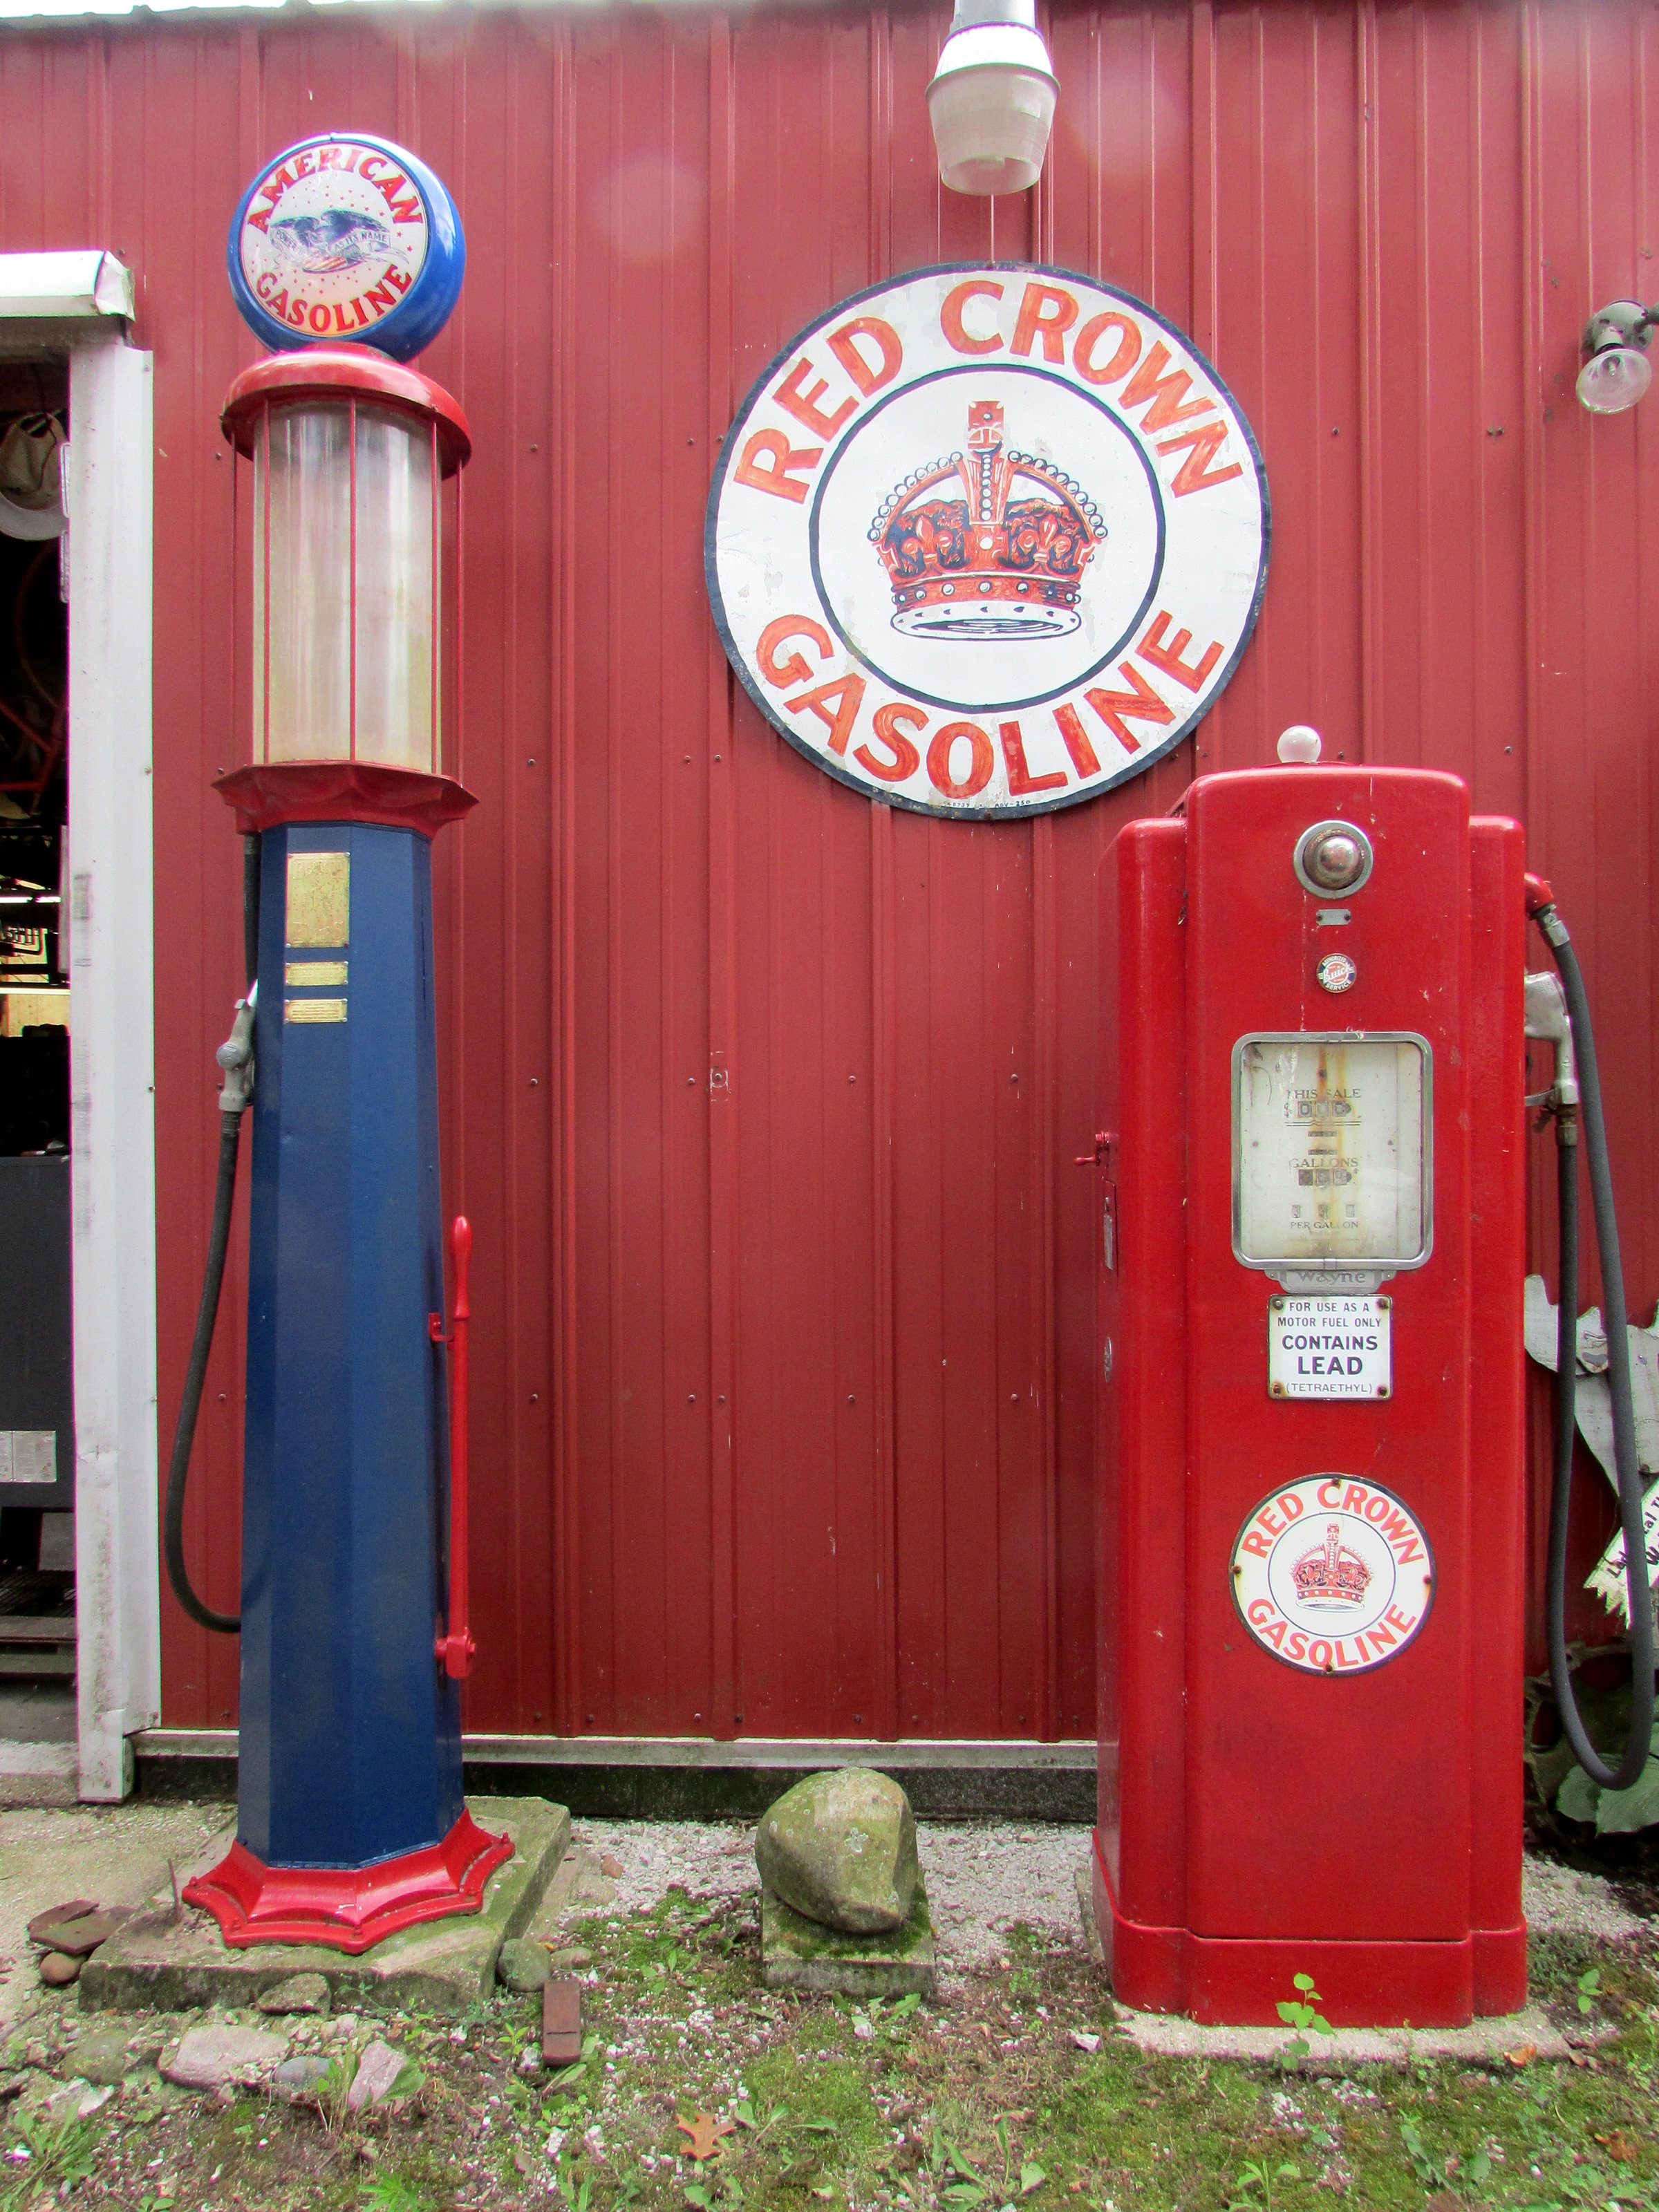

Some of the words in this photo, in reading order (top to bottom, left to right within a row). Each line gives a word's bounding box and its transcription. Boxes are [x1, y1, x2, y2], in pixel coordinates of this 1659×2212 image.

[247, 148, 424, 234] AMERICAN
[361, 232, 387, 243] NAME
[256, 263, 413, 332] GASOLINE
[732, 317, 905, 505] RED
[940, 280, 1244, 498] CROWN
[755, 609, 1226, 799] GASOLINE
[1325, 979, 1352, 991] SERVICE
[1286, 1089, 1318, 1099] THIS
[1326, 1089, 1361, 1098] SALE
[1290, 1158, 1358, 1168] GALLONS
[1289, 1302, 1311, 1312] FOR
[1317, 1302, 1338, 1312] USE
[1343, 1302, 1357, 1312] AS
[1362, 1303, 1369, 1312] A
[1277, 1317, 1316, 1327] MOTOR
[1322, 1318, 1349, 1327] FUEL
[1354, 1318, 1382, 1327] ONLY
[1282, 1335, 1378, 1351] CONTAINS
[1297, 1356, 1363, 1375] LEAD
[1286, 1383, 1372, 1394] (TETRAETHYL)
[1241, 1492, 1304, 1559] RED
[1317, 1481, 1424, 1565] CROWN
[1247, 1598, 1416, 1667] GASOLINE
